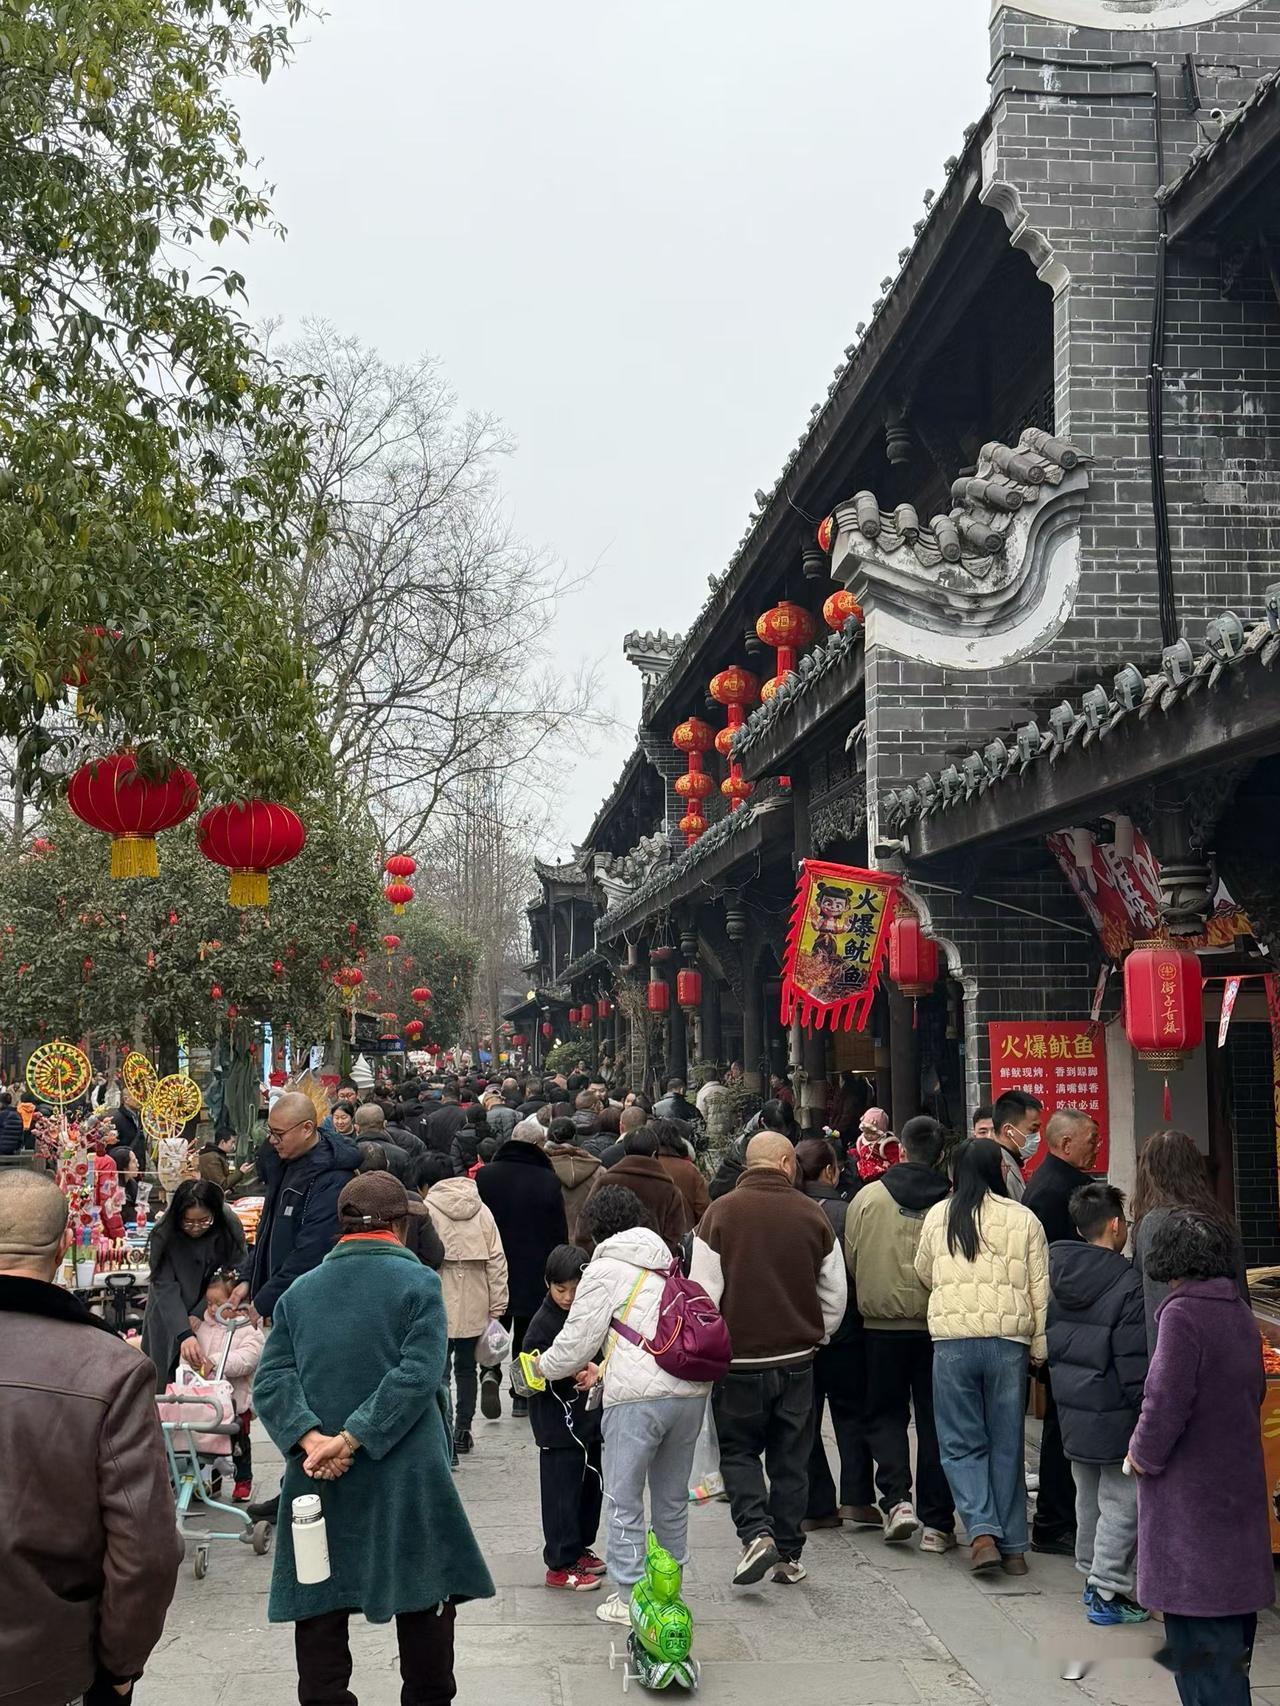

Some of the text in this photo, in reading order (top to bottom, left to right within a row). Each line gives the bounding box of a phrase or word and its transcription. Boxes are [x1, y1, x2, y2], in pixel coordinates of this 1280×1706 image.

[837, 888, 880, 987] 火爆鱿鱼
[1001, 1034, 1096, 1059] 火爆鱿鱼
